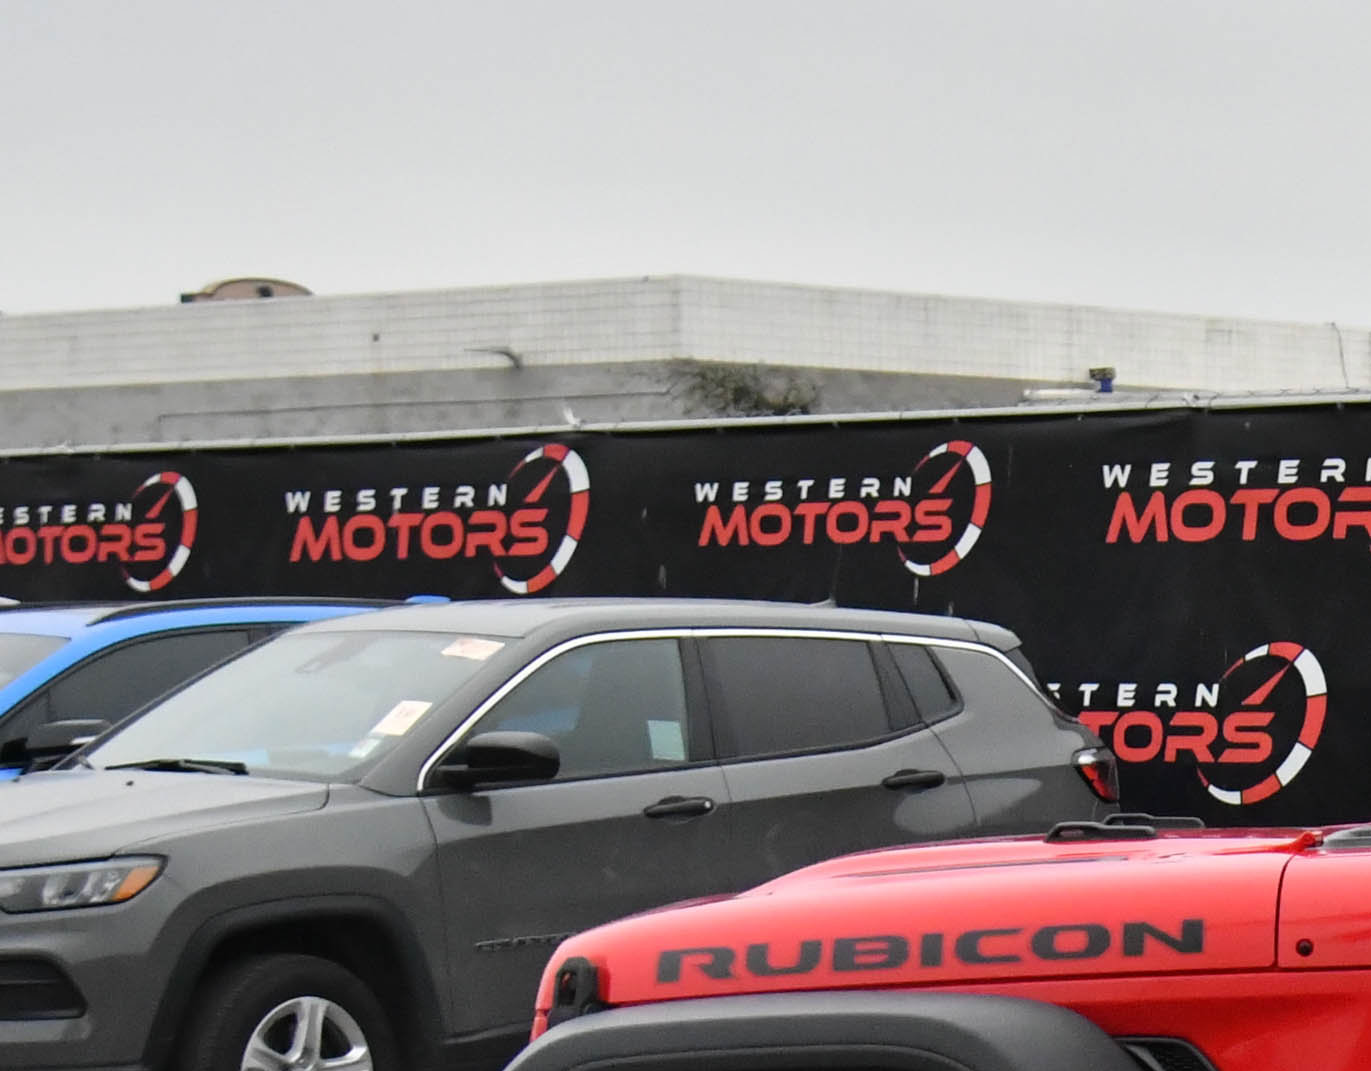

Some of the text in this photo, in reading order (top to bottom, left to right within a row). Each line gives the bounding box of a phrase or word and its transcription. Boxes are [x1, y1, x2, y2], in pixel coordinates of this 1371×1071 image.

[286, 483, 508, 513] WESTERN
[696, 476, 912, 503] WESTERN
[0, 503, 132, 525] STERN
[290, 507, 549, 563] MOTORS
[699, 498, 953, 547] MOTORS
[0, 523, 166, 565] OTORS
[656, 918, 1204, 983] RUBICON
